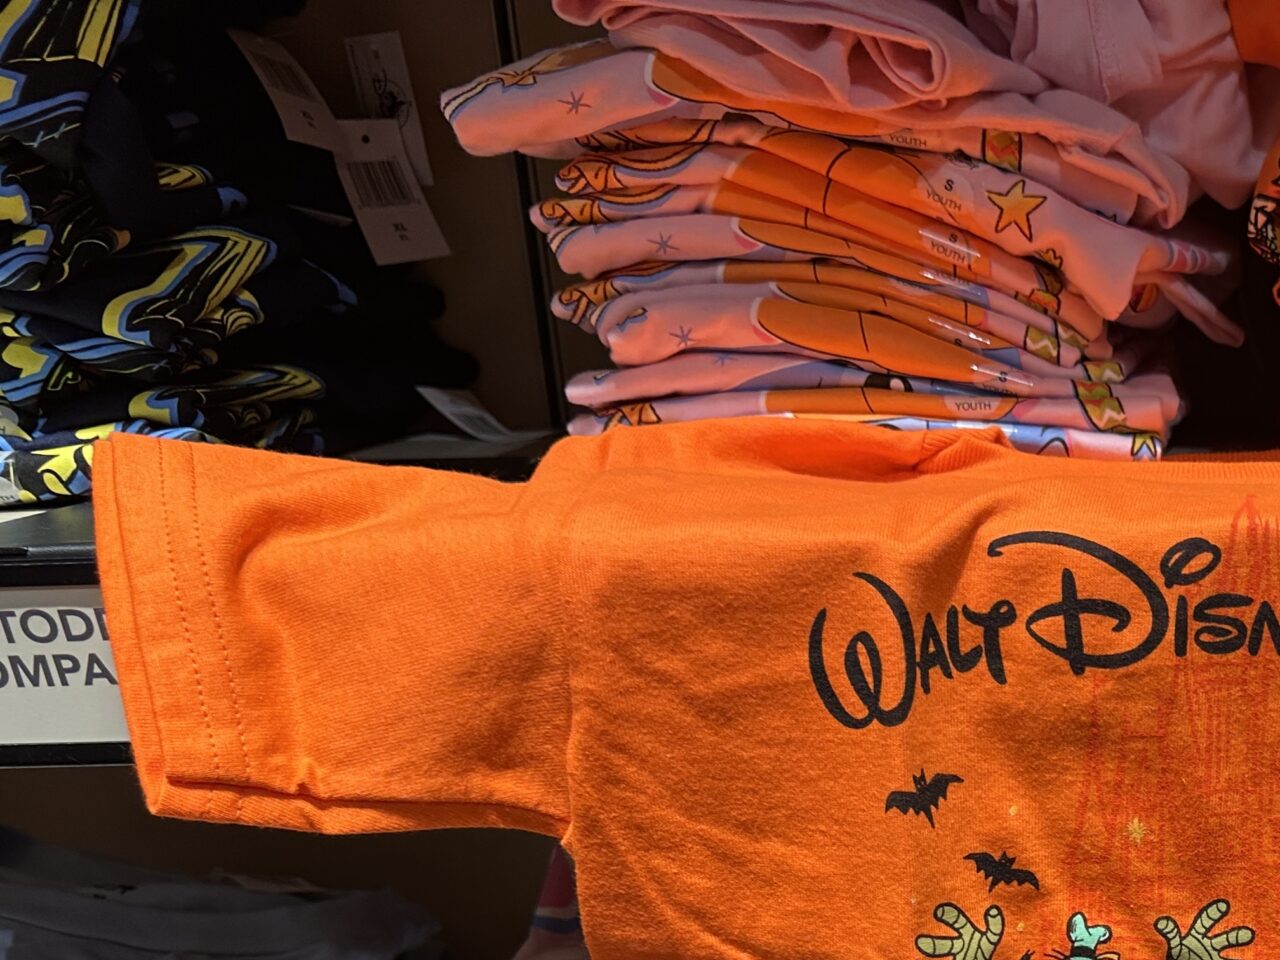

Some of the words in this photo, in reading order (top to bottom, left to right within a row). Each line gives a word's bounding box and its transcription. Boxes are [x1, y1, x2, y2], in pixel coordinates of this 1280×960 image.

[888, 133, 928, 148] YOUTH
[944, 178, 955, 192] S
[926, 188, 962, 212] YOUTH
[948, 232, 959, 243] S
[930, 240, 967, 264] YOUTH
[954, 401, 992, 412] YOUTH
